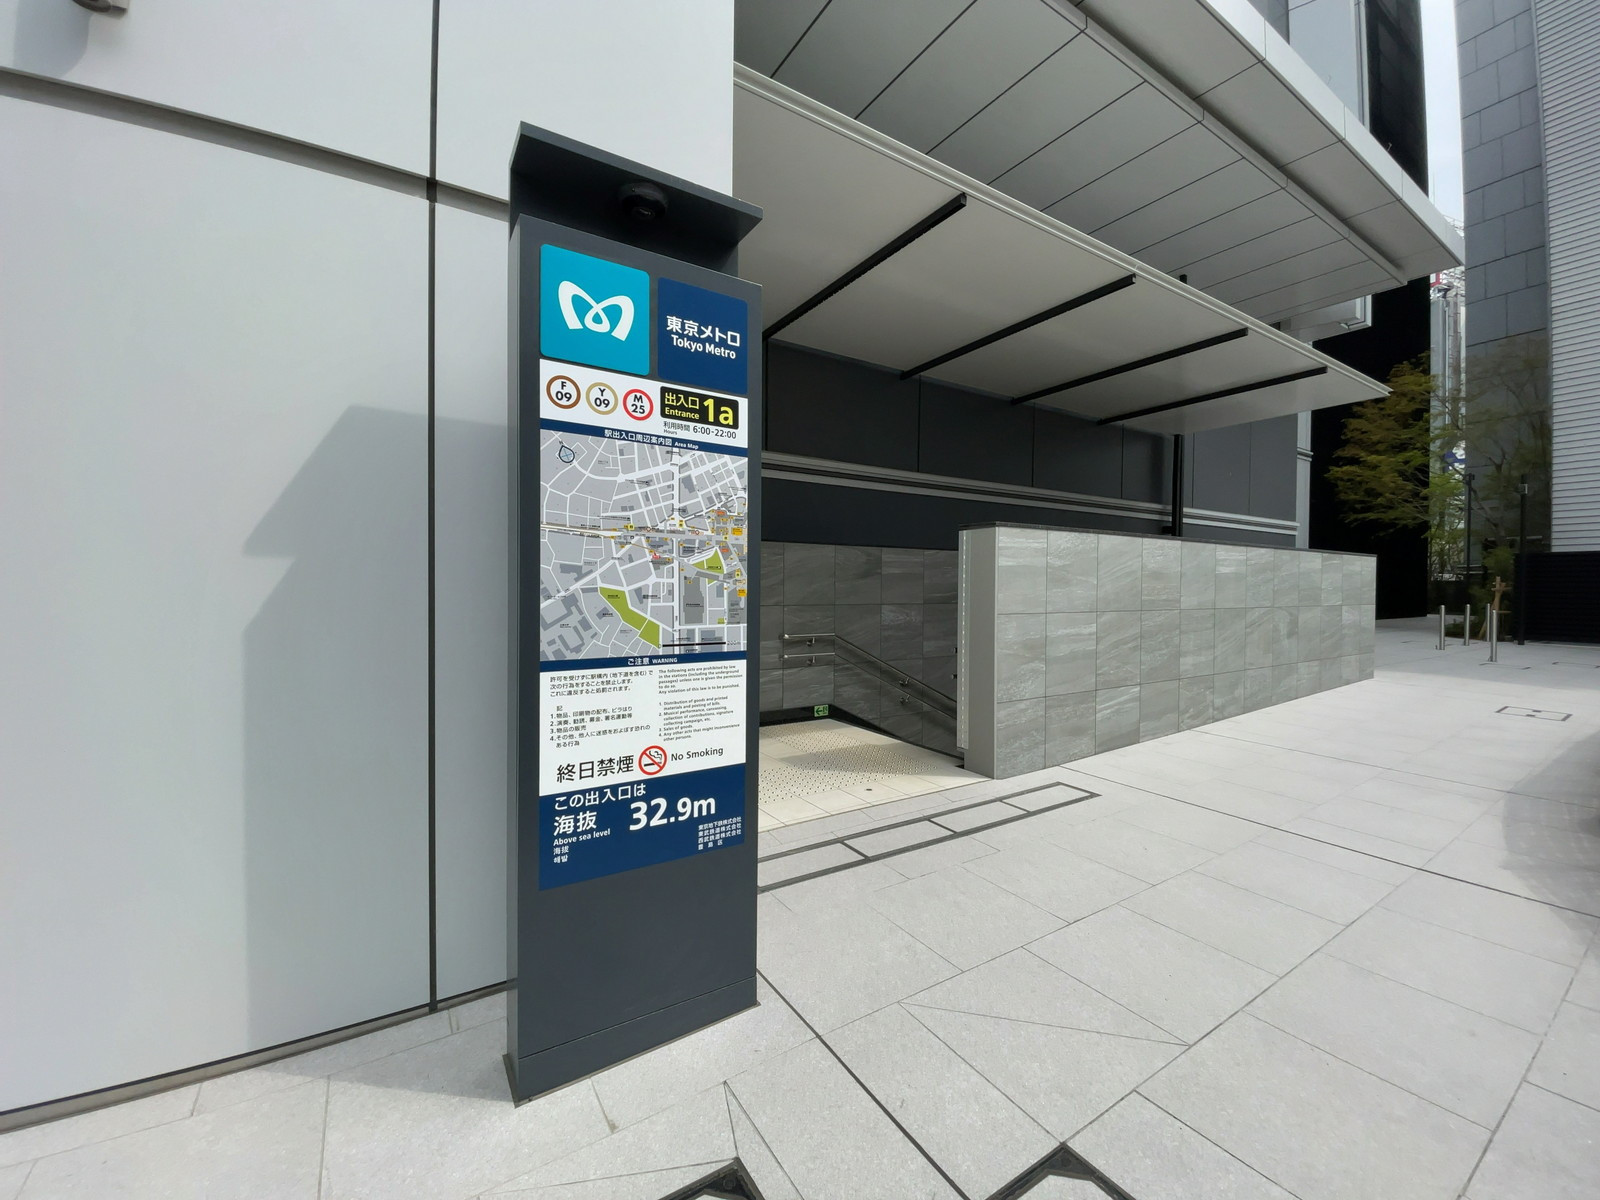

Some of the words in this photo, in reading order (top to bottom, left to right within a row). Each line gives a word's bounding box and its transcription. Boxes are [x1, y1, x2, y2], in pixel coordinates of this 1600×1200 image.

[666, 315, 740, 347] 東京メトロ
[671, 334, 703, 352] Tokyo
[706, 342, 736, 359] Metro
[561, 381, 566, 390] F
[598, 388, 606, 396] Y
[555, 391, 572, 402] 09
[594, 398, 610, 408] 09
[633, 394, 644, 404] M
[664, 392, 700, 409] 出入口
[631, 404, 646, 414] 25
[664, 407, 700, 420] Entrance
[703, 398, 734, 426] 1a
[604, 429, 672, 446] 駅出入口周辺案内図
[663, 420, 690, 432] 利用時間
[692, 426, 737, 439] 6:00-22:00
[671, 752, 684, 762] No
[686, 746, 724, 760] Smoking
[556, 754, 634, 783] 終日禁煙
[554, 783, 646, 810] この出入口は
[629, 797, 715, 831] 32.9m
[554, 811, 597, 836] 海抜
[553, 836, 577, 846] Above
[578, 833, 591, 841] sea
[593, 828, 610, 838] level
